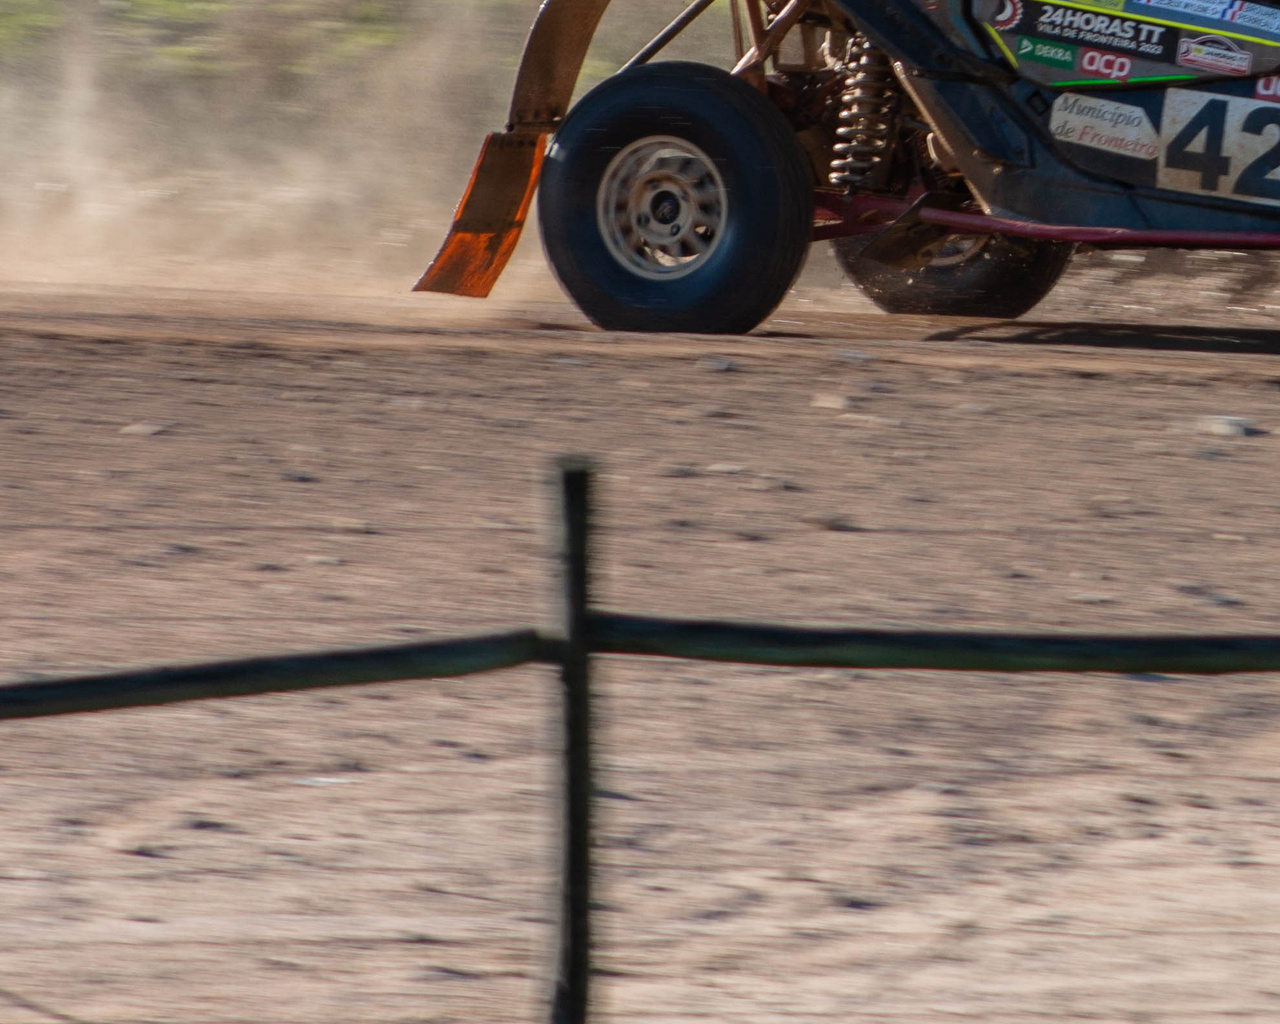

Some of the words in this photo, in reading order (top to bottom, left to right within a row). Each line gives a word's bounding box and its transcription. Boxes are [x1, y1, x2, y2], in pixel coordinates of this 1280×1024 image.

[1037, 5, 1137, 38] 24HORAS
[1138, 25, 1166, 44] TT
[1037, 22, 1062, 36] VILA
[1062, 28, 1077, 39] DE
[1077, 29, 1137, 49] FRONTEIRA
[1137, 42, 1164, 54] 2023
[1035, 43, 1072, 62] DEKRA
[1082, 51, 1132, 78] acp
[1054, 120, 1075, 139] de
[1077, 125, 1159, 157] Fronteira
